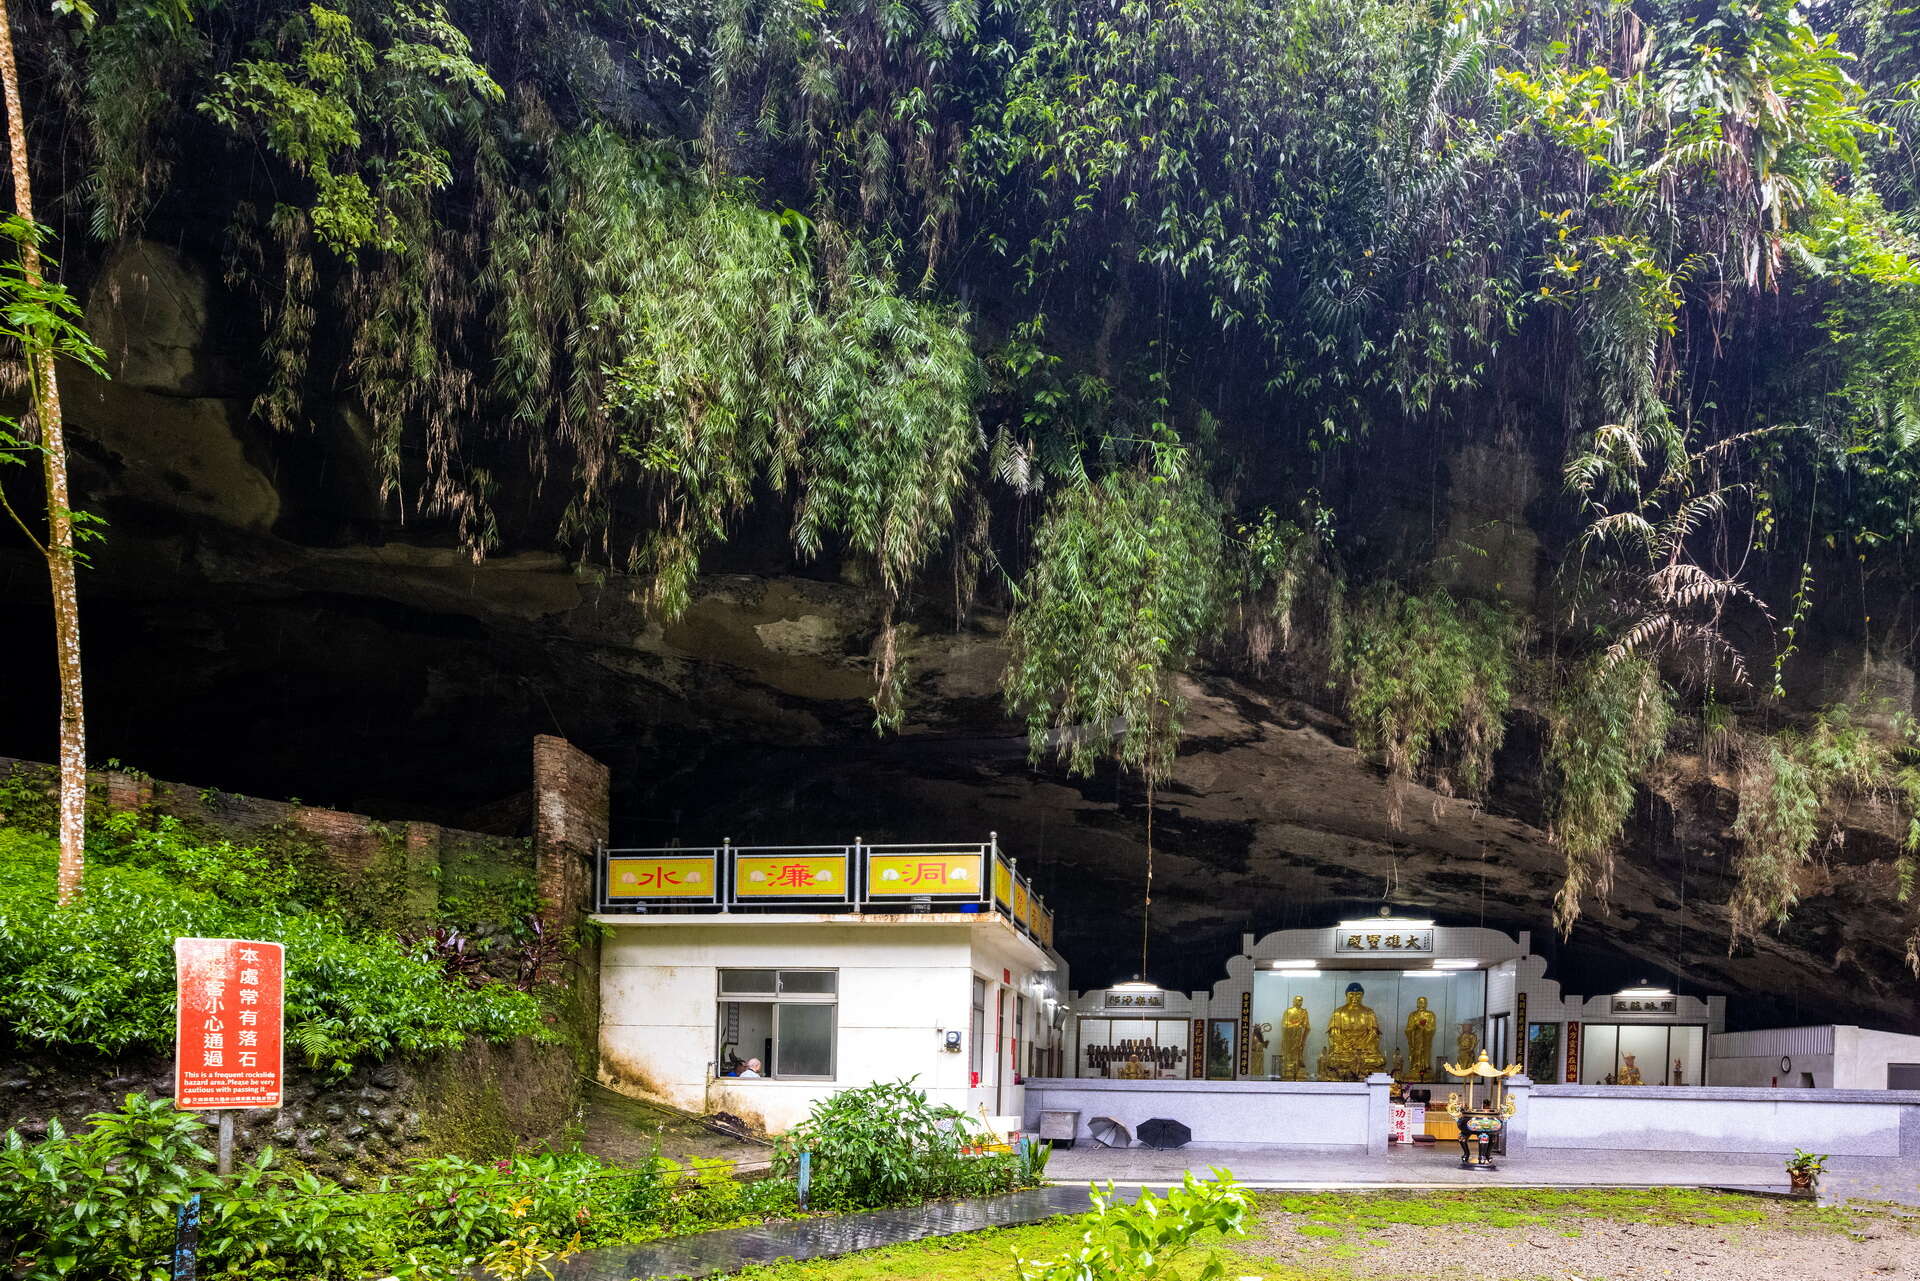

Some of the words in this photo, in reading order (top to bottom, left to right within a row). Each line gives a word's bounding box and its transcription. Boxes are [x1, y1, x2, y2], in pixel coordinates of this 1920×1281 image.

[637, 866, 683, 889] 水
[901, 862, 948, 886] 洞
[238, 947, 259, 1067] 本處常有落石
